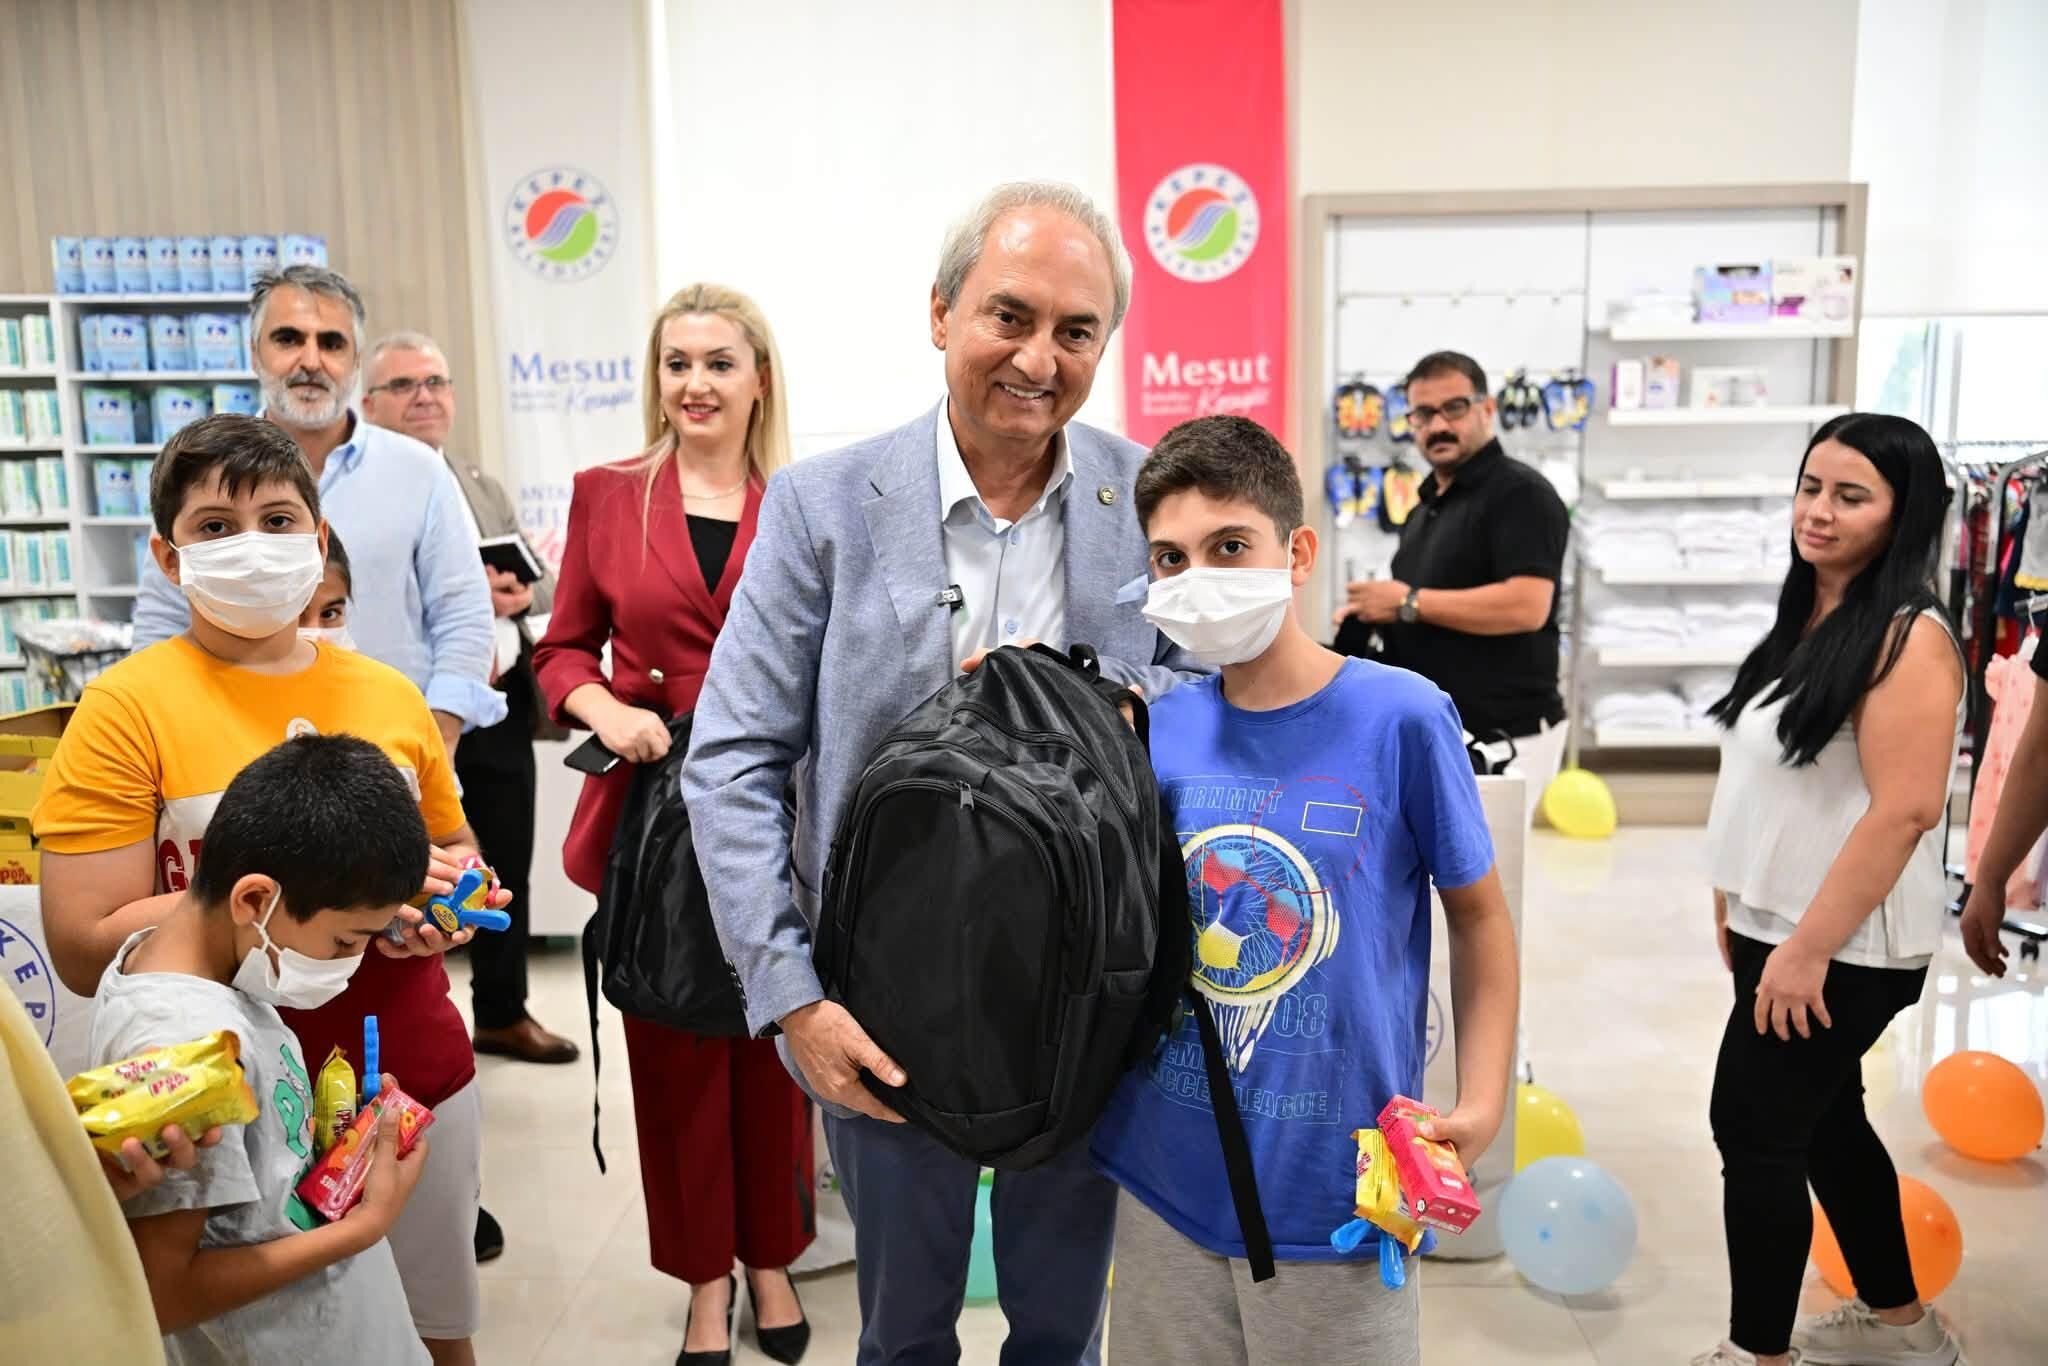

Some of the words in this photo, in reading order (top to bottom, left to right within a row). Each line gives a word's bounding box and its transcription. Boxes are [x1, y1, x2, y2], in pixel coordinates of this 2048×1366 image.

[511, 352, 634, 383] Mesut
[1143, 352, 1270, 387] Mesut
[1273, 993, 1328, 1039] 08
[1235, 1086, 1328, 1120] LEAGUE
